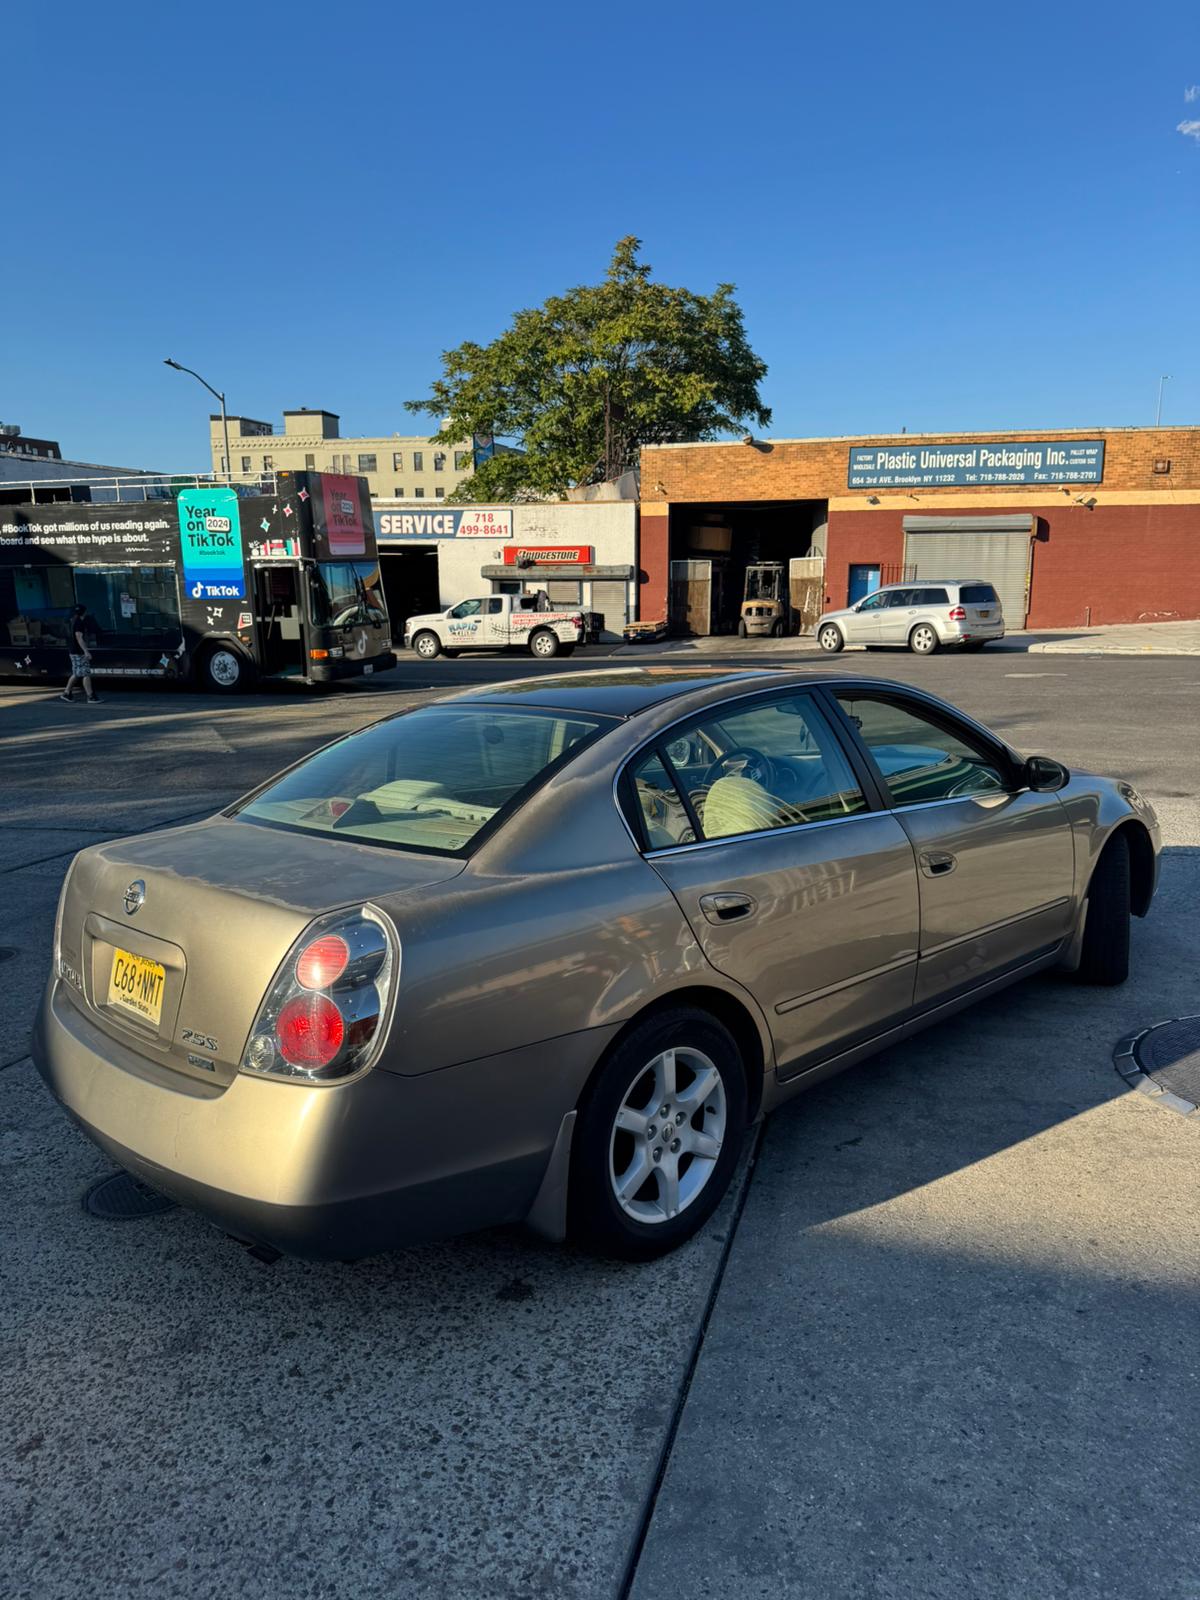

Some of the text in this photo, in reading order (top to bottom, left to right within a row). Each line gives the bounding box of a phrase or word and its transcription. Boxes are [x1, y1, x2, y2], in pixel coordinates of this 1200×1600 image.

[877, 448, 1069, 470] Plastic Universal Packaging Inc.
[895, 475, 921, 485] Brooklyn
[935, 474, 955, 482] 11232
[185, 506, 216, 518] Year
[475, 513, 494, 522] 718
[2, 524, 42, 533] #BookTok
[43, 524, 57, 534] got
[59, 522, 89, 532] millions
[90, 521, 100, 530] of
[111, 520, 143, 532] reading
[144, 519, 170, 529] again.
[187, 521, 204, 531] on
[207, 519, 228, 528] 2024
[380, 515, 454, 534] SERVICE
[460, 525, 508, 535] 499-8641
[24, 536, 39, 545] and
[41, 536, 55, 545] see
[56, 535, 76, 544] what
[77, 534, 91, 543] the
[92, 534, 112, 545] hype
[113, 533, 121, 543] is
[122, 533, 149, 543] about.
[188, 533, 234, 547] TikTok
[518, 550, 579, 560] BRIDGESTONE
[205, 585, 239, 596] TikTok
